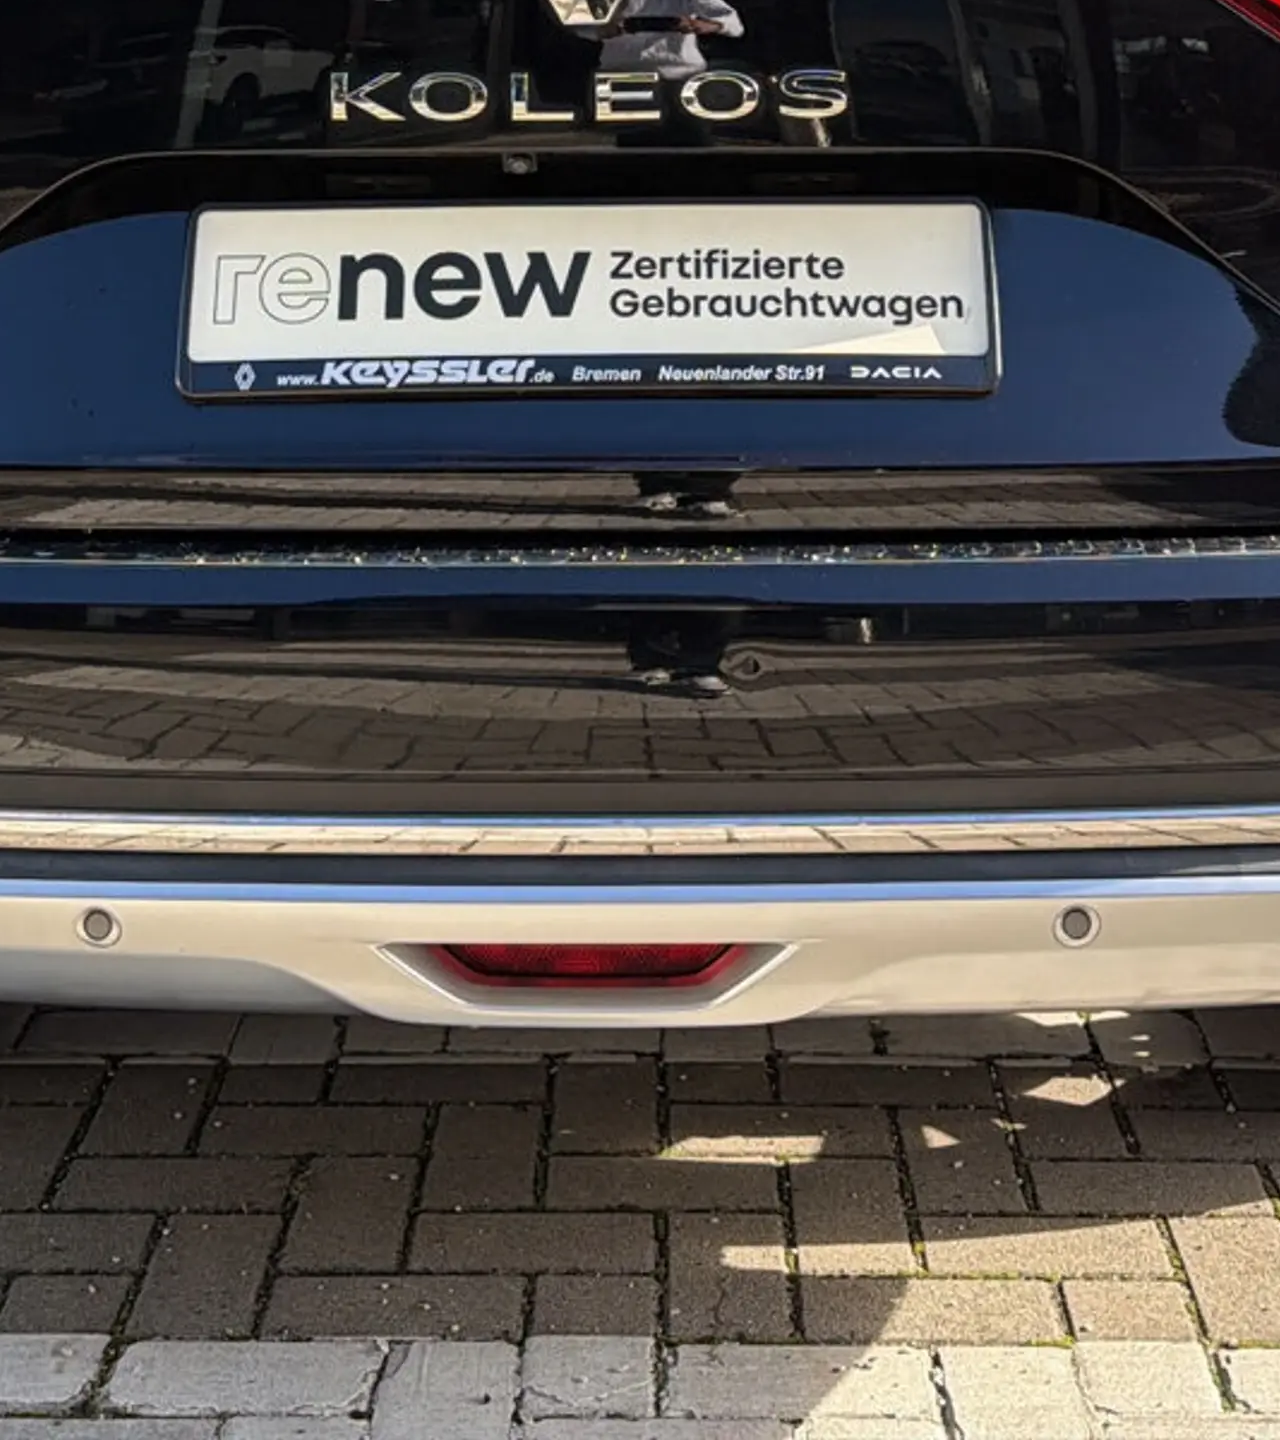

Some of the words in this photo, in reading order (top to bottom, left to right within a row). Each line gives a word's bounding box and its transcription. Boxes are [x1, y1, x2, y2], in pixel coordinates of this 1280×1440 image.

[329, 68, 849, 123] KOLEOS
[610, 249, 845, 280] Zertifizierte
[213, 251, 592, 325] renew
[610, 287, 964, 326] Gebrauchtwagen
[571, 366, 642, 383] Bremen
[850, 366, 943, 379] DACIA
